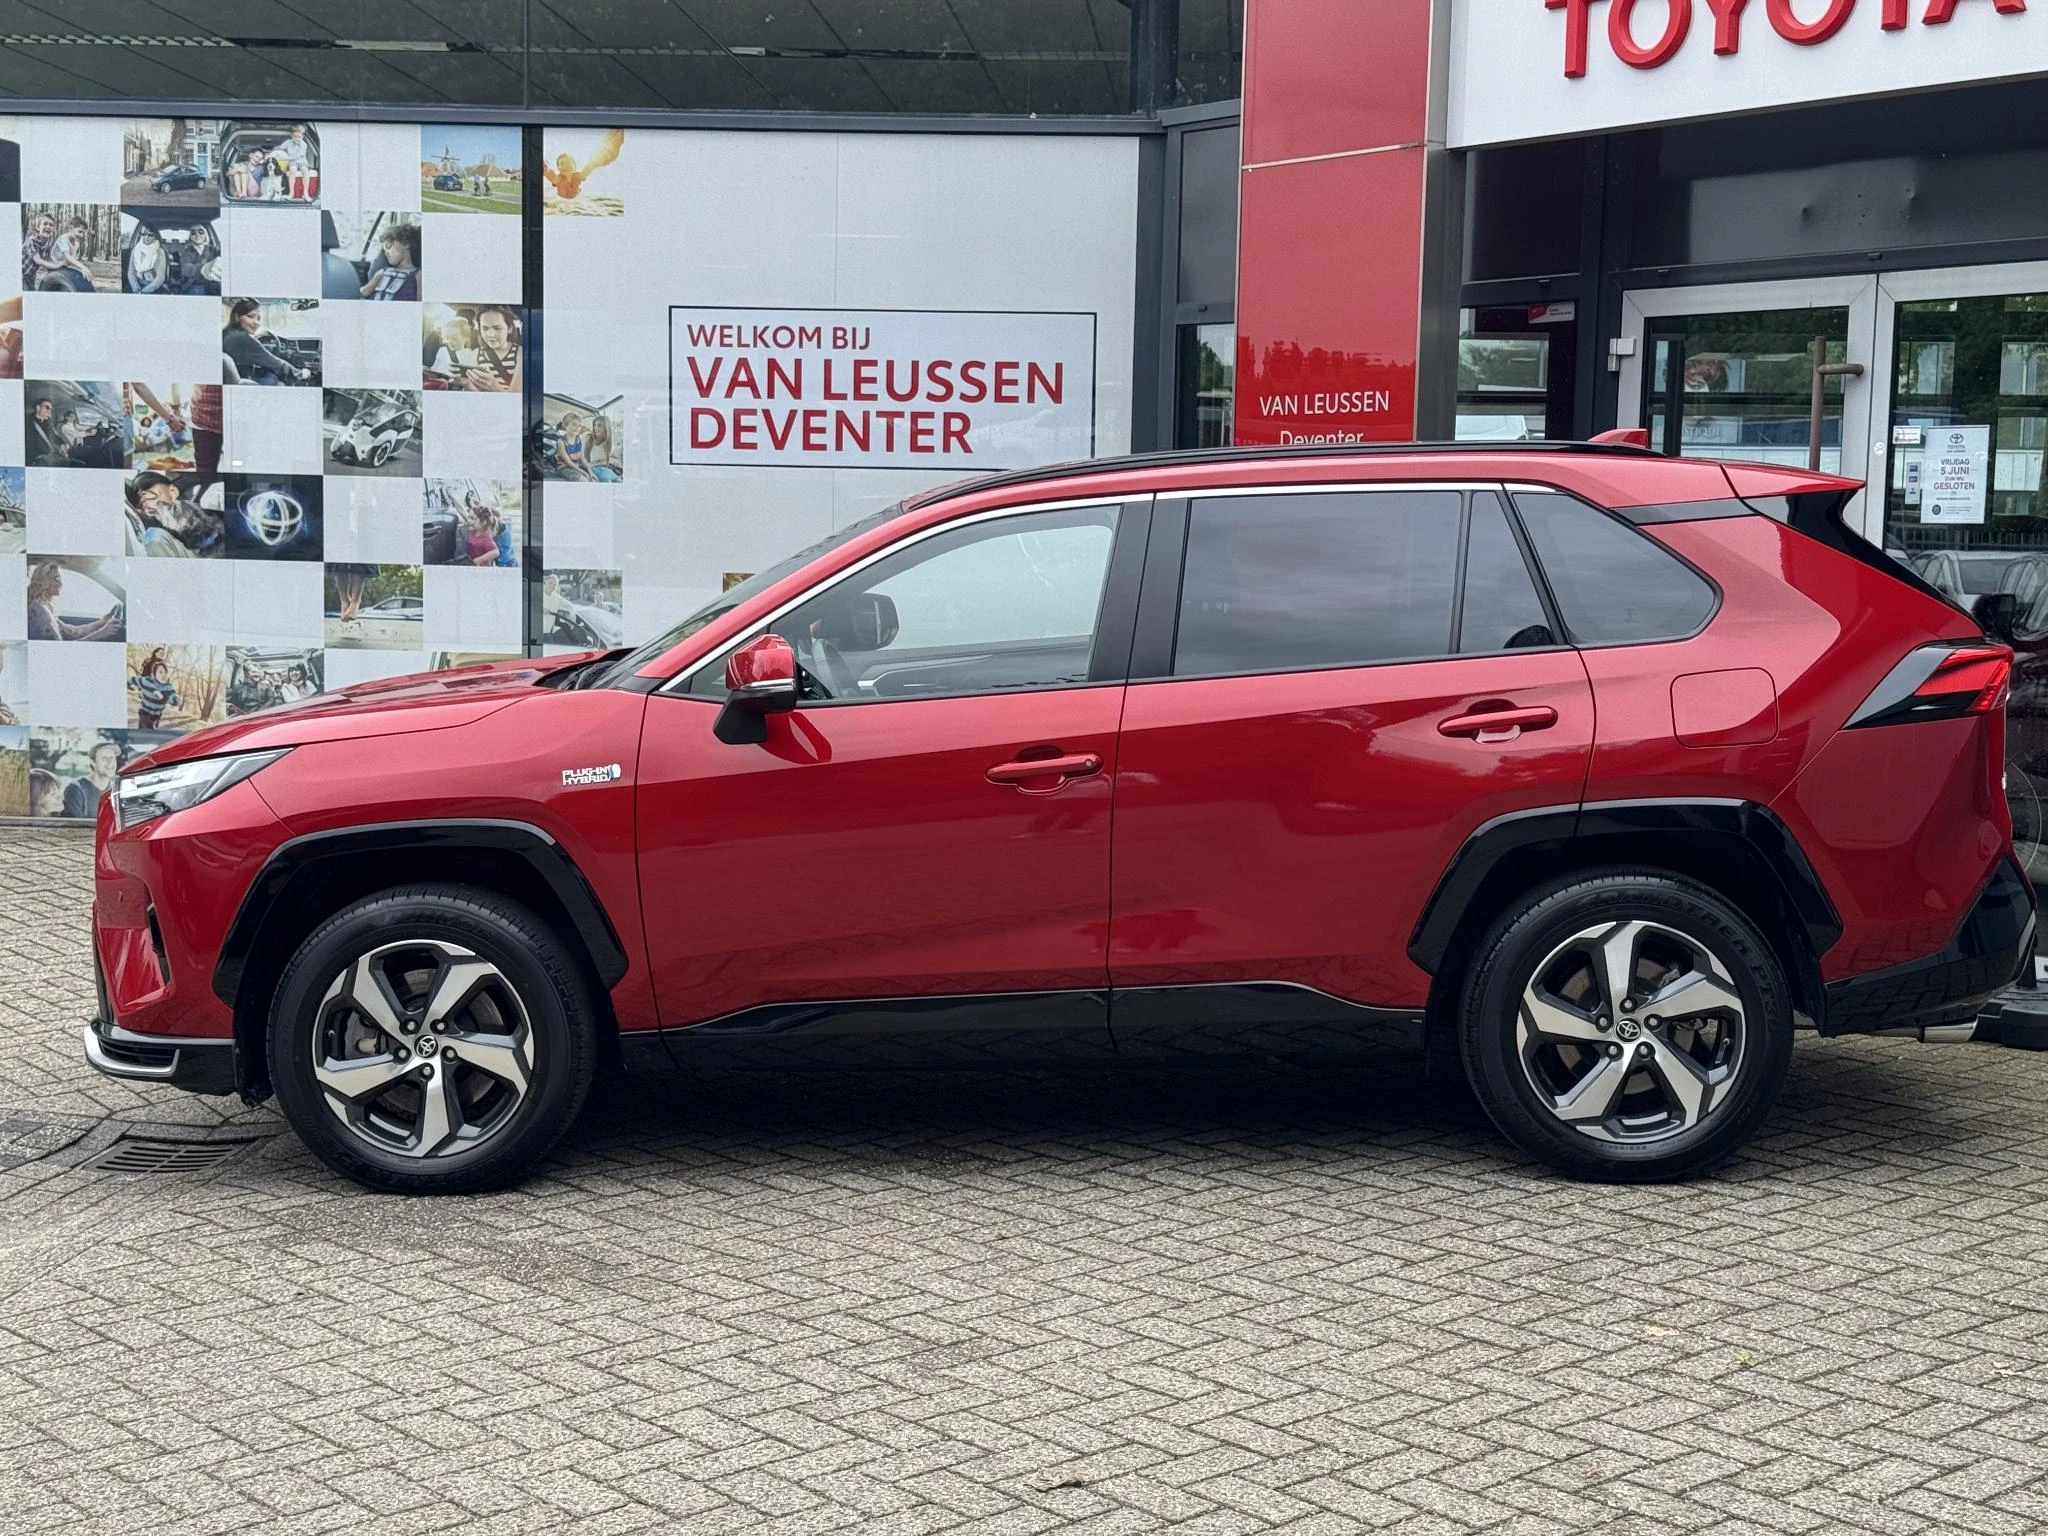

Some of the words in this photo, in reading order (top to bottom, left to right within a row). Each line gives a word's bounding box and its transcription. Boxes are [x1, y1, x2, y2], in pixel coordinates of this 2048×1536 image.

[1546, 0, 2027, 79] TOYO
[687, 324, 822, 349] WELKOM
[832, 327, 871, 350] BIJ
[687, 356, 802, 400] VAN
[823, 358, 1063, 404] LEUSSEN
[1259, 394, 1298, 416] VAN
[1304, 390, 1390, 415] LEUSSEN
[690, 407, 973, 454] DEVENTER
[1940, 458, 1970, 466] VRIJDAG
[1940, 466, 1946, 475] 5
[1948, 466, 1970, 475] JUNI
[1933, 482, 1975, 490] GESLOTEN
[561, 764, 611, 778] PLUG-IN
[562, 774, 610, 786] HYBRID
